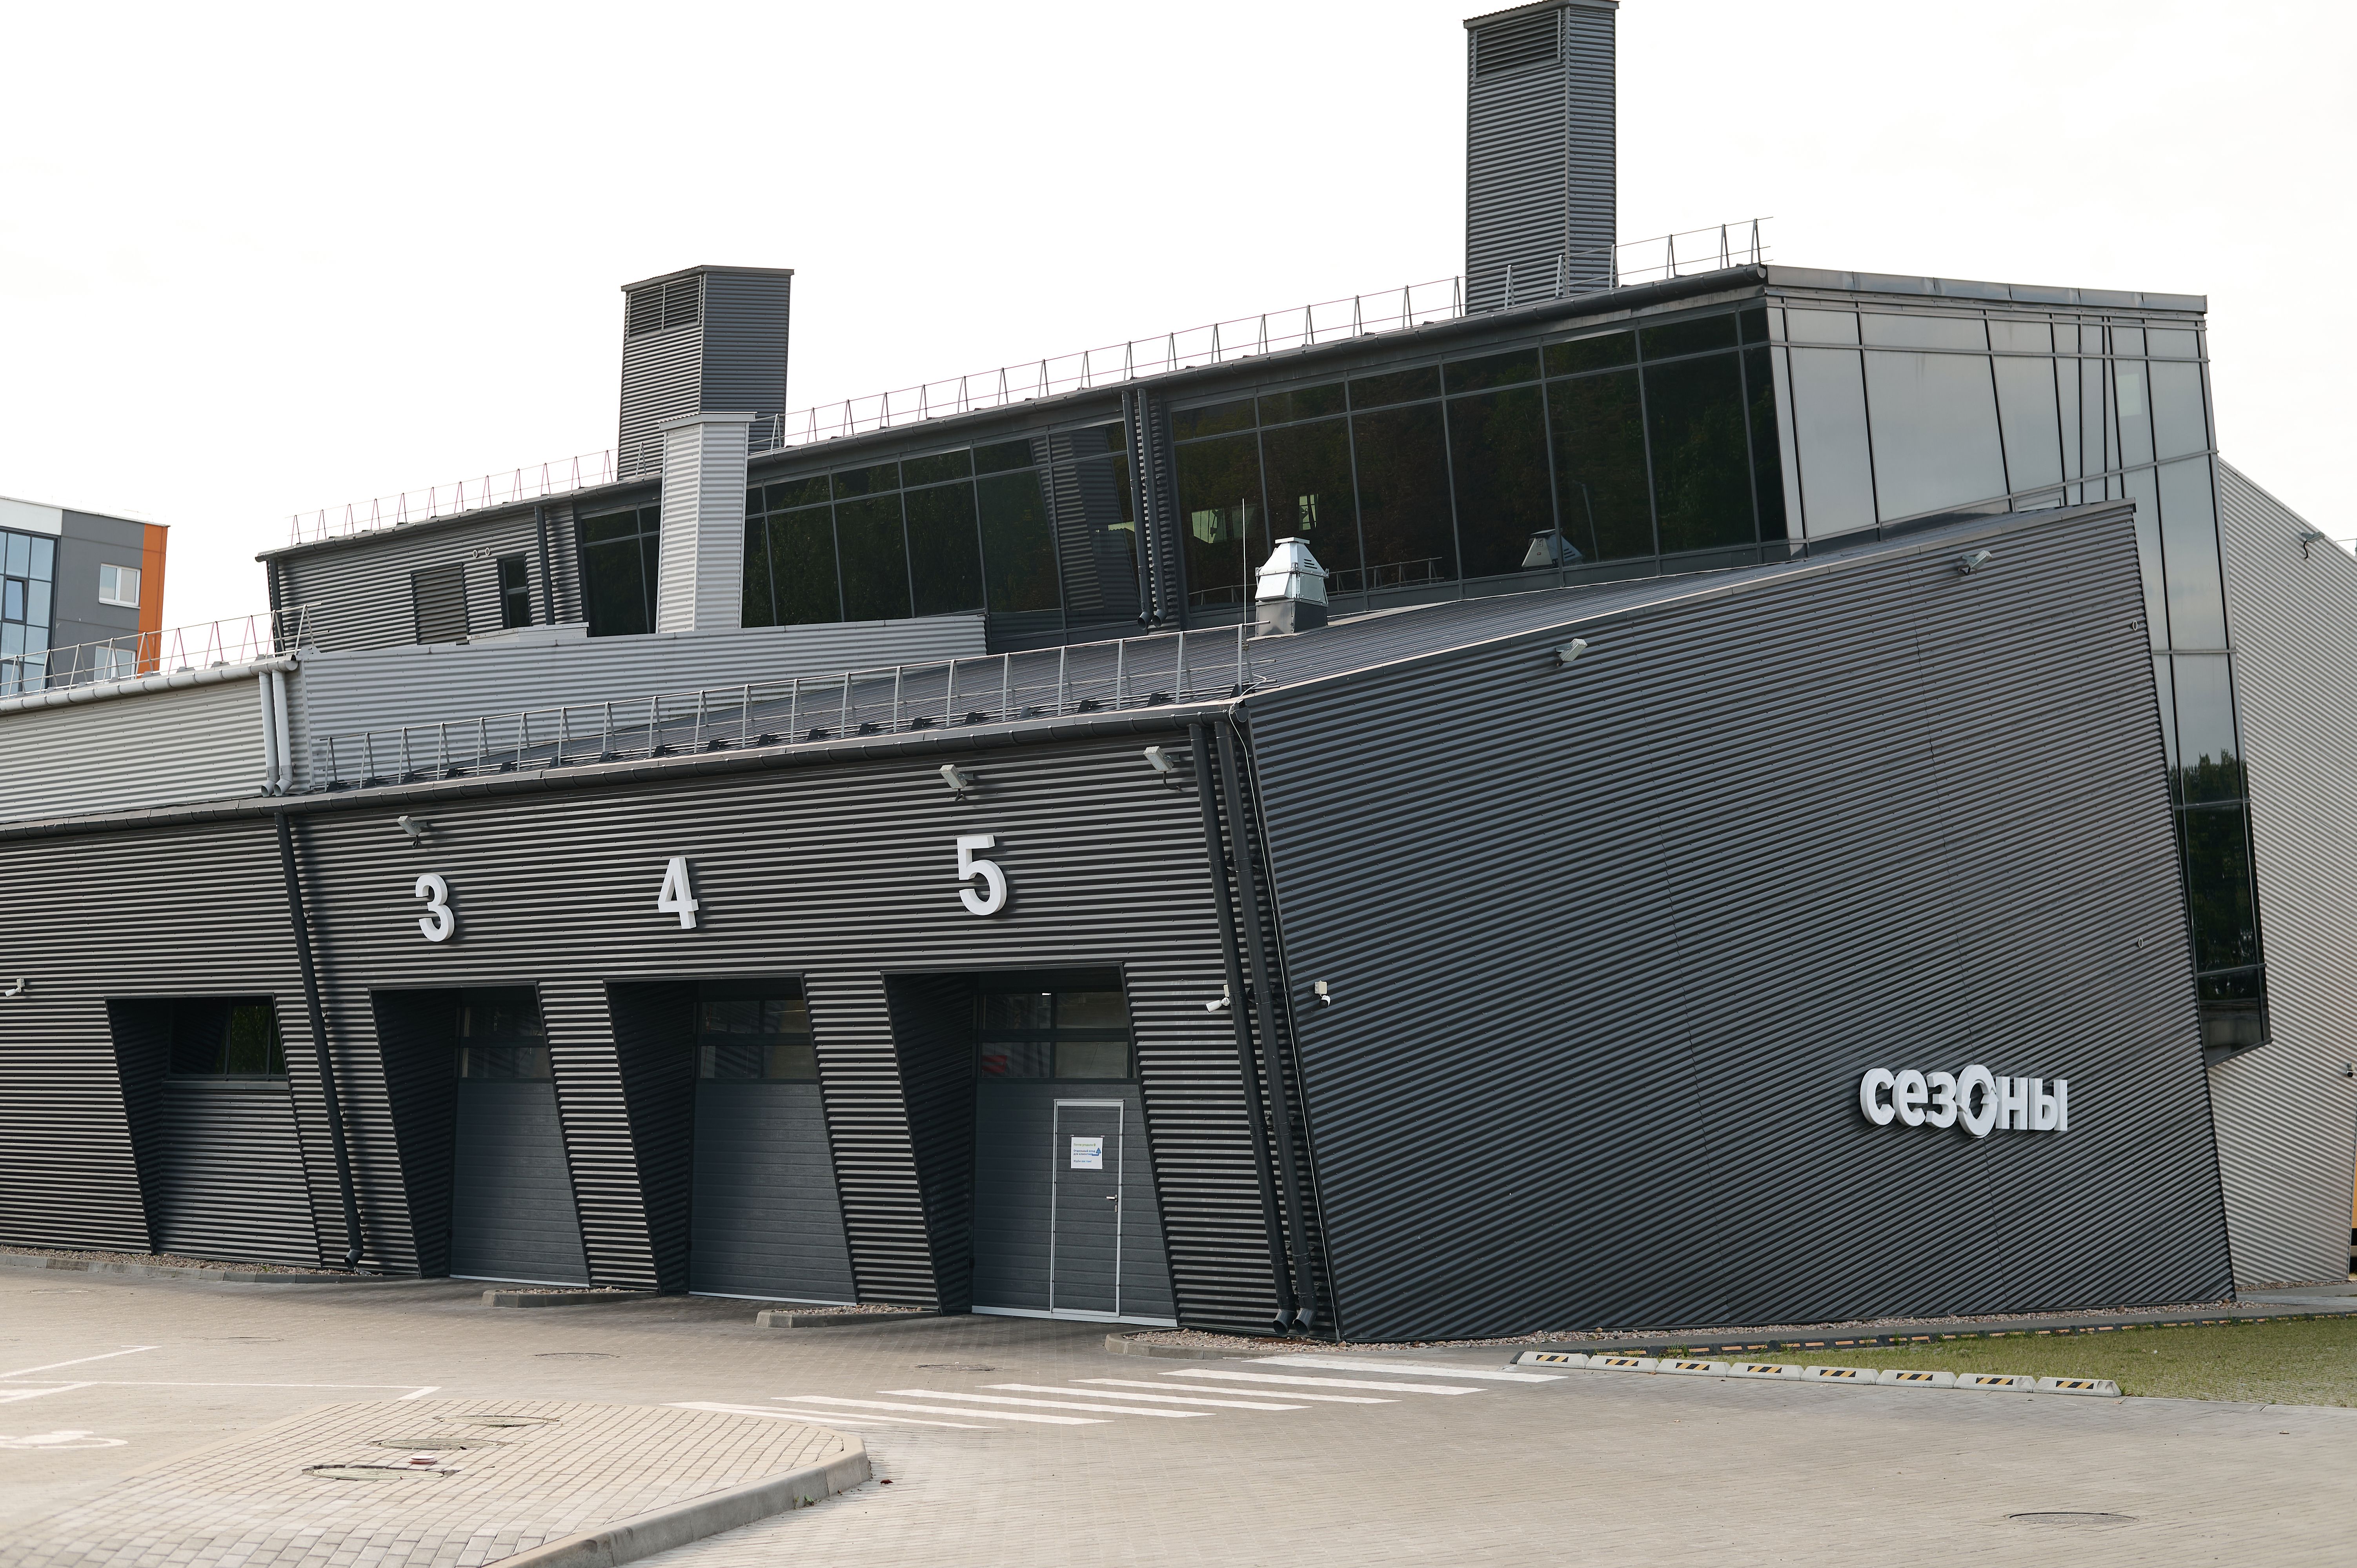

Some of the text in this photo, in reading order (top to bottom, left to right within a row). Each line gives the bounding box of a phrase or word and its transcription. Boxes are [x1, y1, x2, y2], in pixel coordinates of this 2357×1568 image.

[415, 873, 455, 942] 3
[658, 857, 699, 930] 4
[957, 834, 1007, 916] 5
